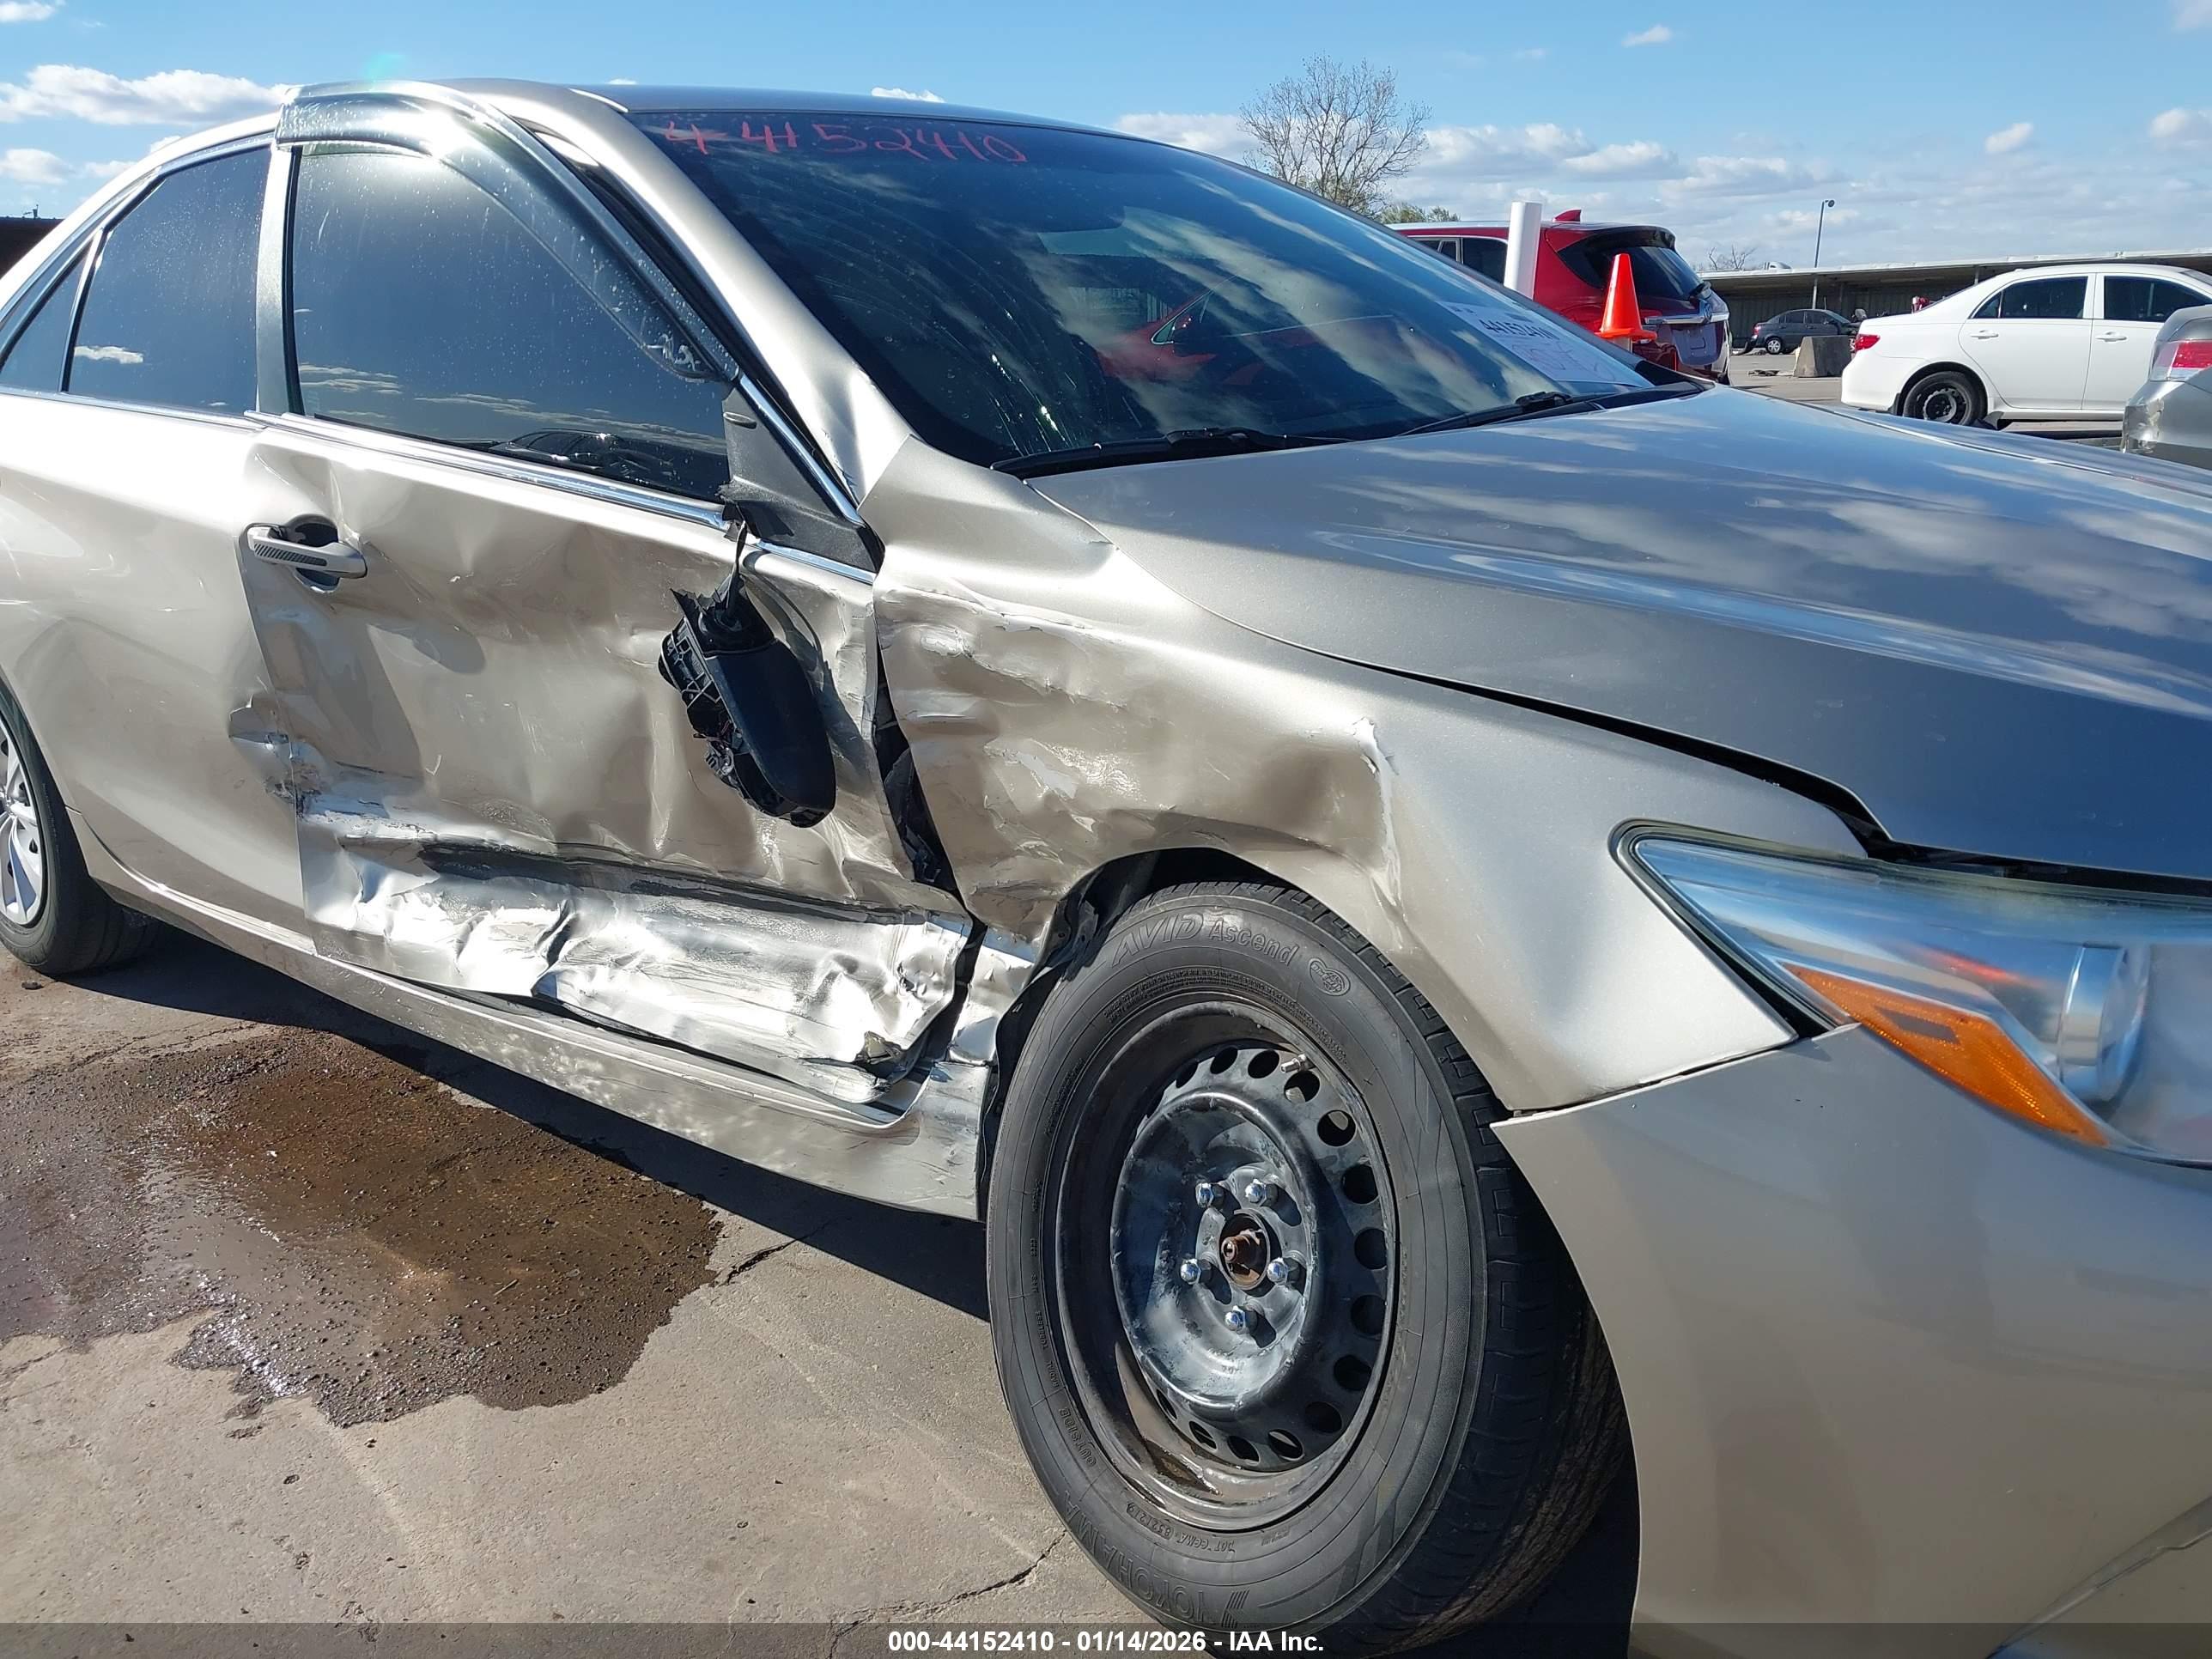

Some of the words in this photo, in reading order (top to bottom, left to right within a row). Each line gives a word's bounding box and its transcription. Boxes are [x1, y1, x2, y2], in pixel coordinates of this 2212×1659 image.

[1111, 913, 1205, 968] AVID
[1207, 918, 1300, 966] Ascend
[1064, 1490, 1215, 1625] YOKOHAMA
